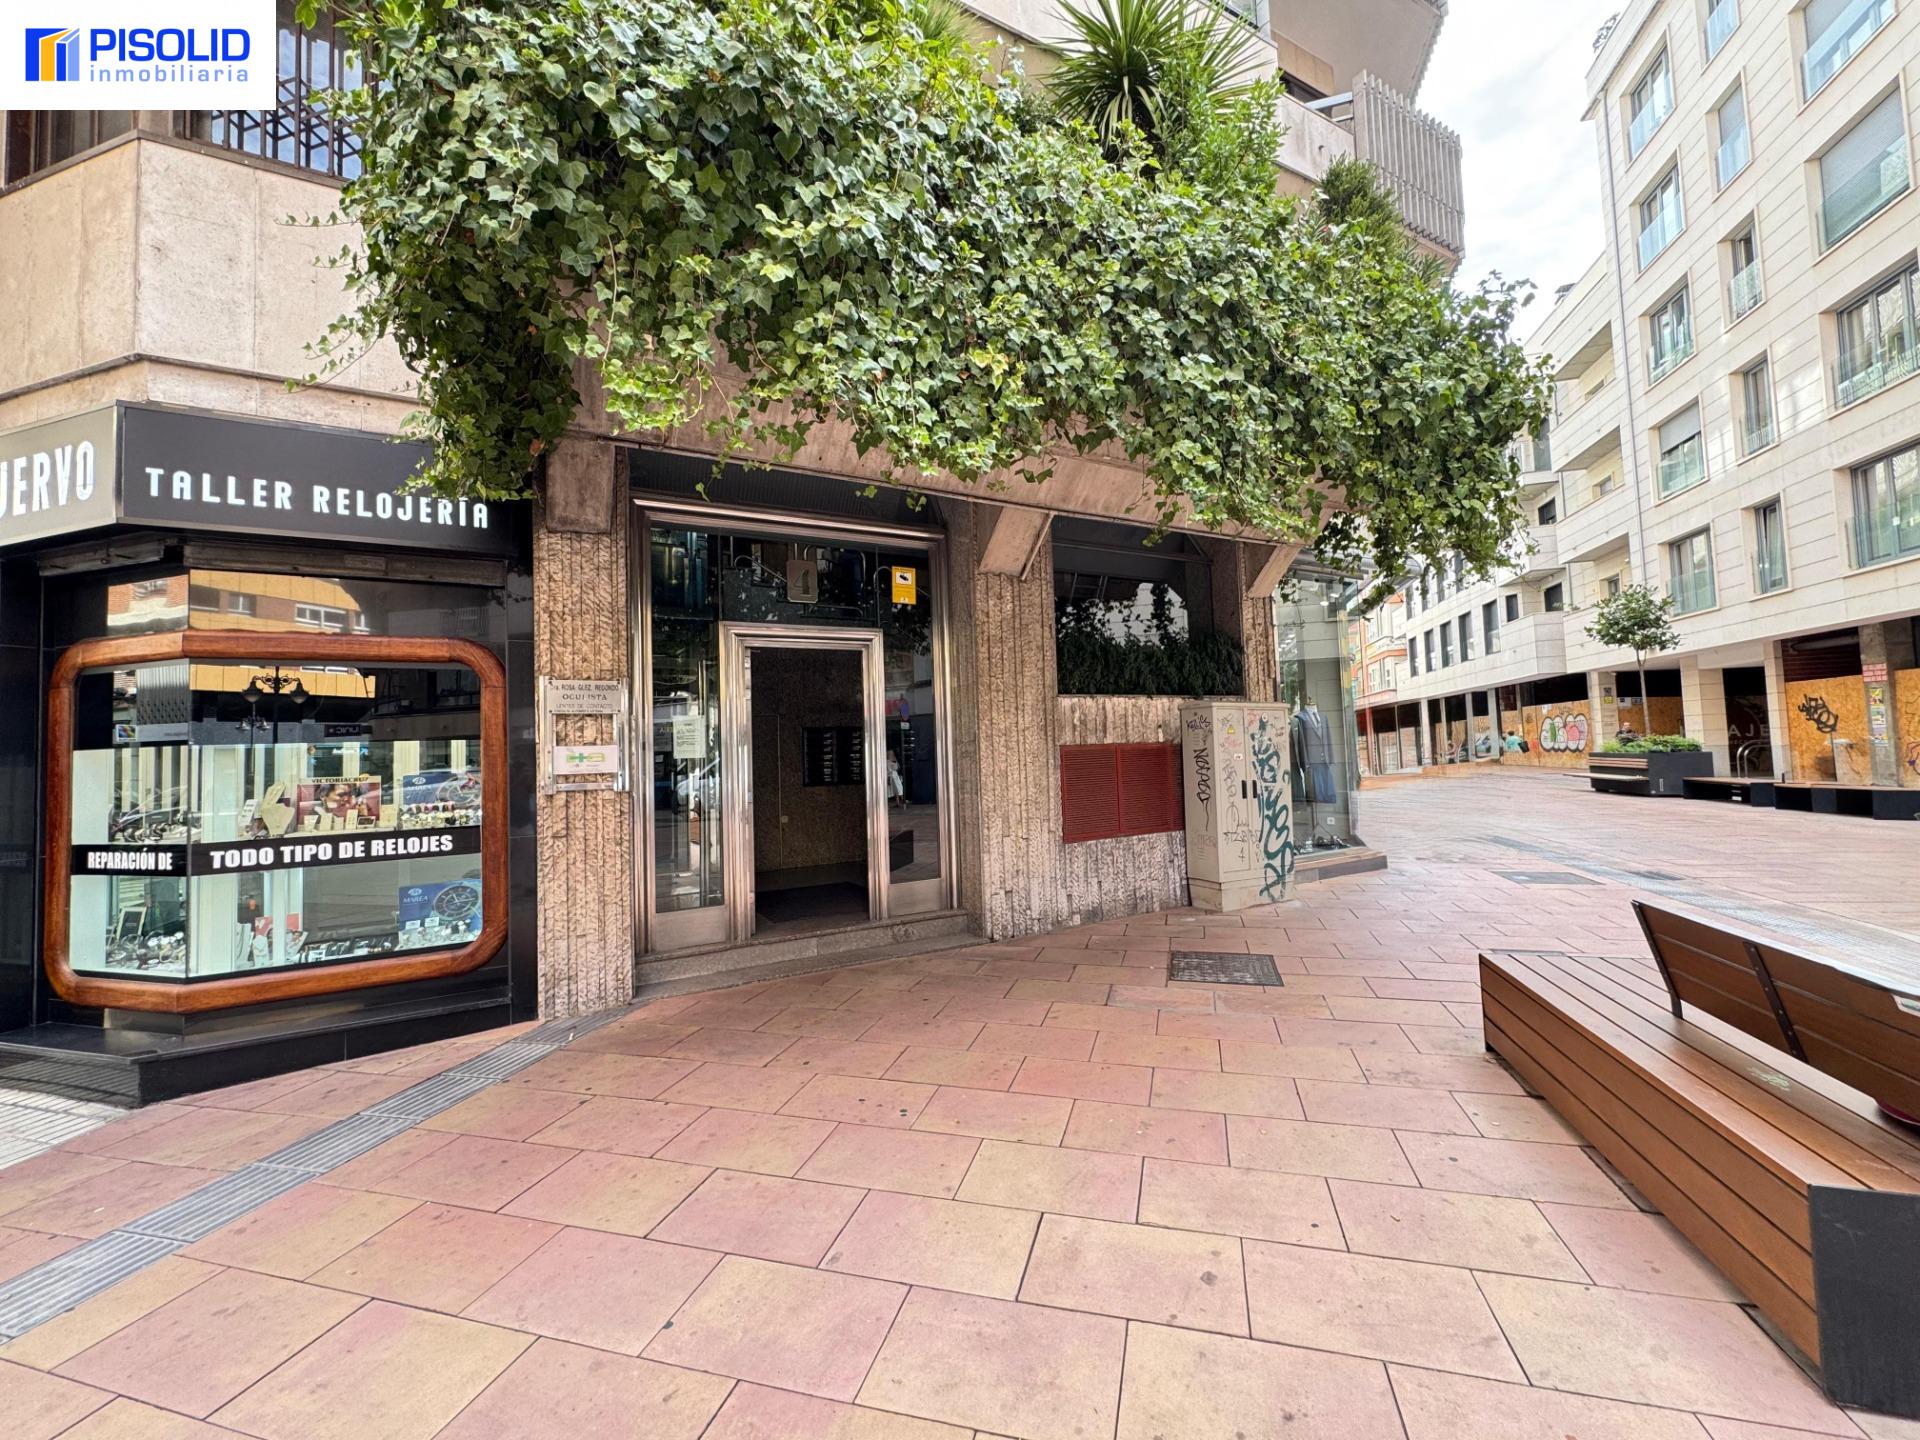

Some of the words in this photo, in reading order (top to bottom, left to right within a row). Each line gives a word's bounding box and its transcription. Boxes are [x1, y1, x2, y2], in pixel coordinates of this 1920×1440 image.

[145, 467, 292, 510] TALLER
[313, 485, 488, 529] RELOJERÍA
[88, 847, 155, 870] REPARACIÓN
[158, 852, 173, 871] DE
[210, 847, 274, 869] TODO
[280, 843, 332, 863] TIPO
[339, 840, 366, 859] DE
[371, 834, 453, 857] RELOJES
